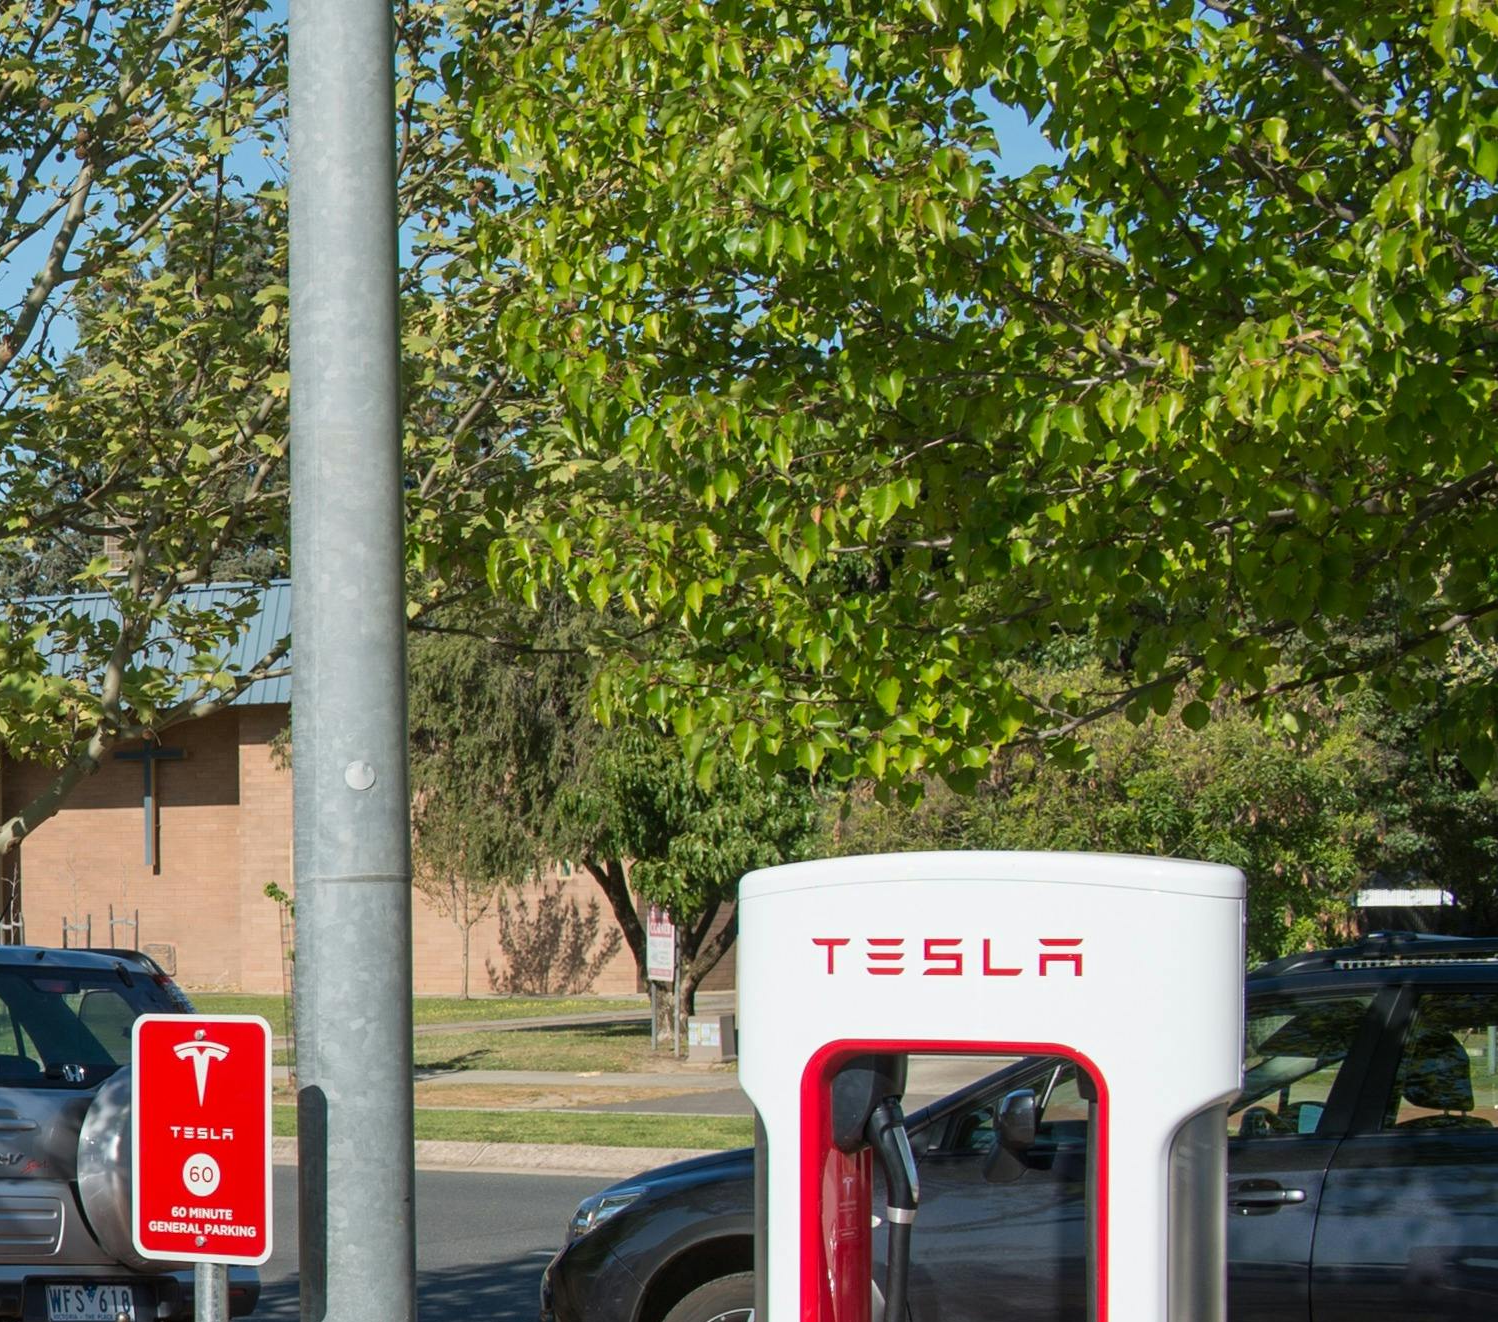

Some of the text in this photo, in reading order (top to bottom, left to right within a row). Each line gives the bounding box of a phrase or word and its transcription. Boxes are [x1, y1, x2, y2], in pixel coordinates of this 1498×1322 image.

[811, 938, 1083, 976] TESLA
[170, 1126, 234, 1140] TESLA
[189, 1166, 213, 1183] 60
[171, 1206, 233, 1221] 60 MINUTE
[148, 1220, 257, 1237] GENERAL PARKING
[49, 1288, 131, 1314] WFS 618
